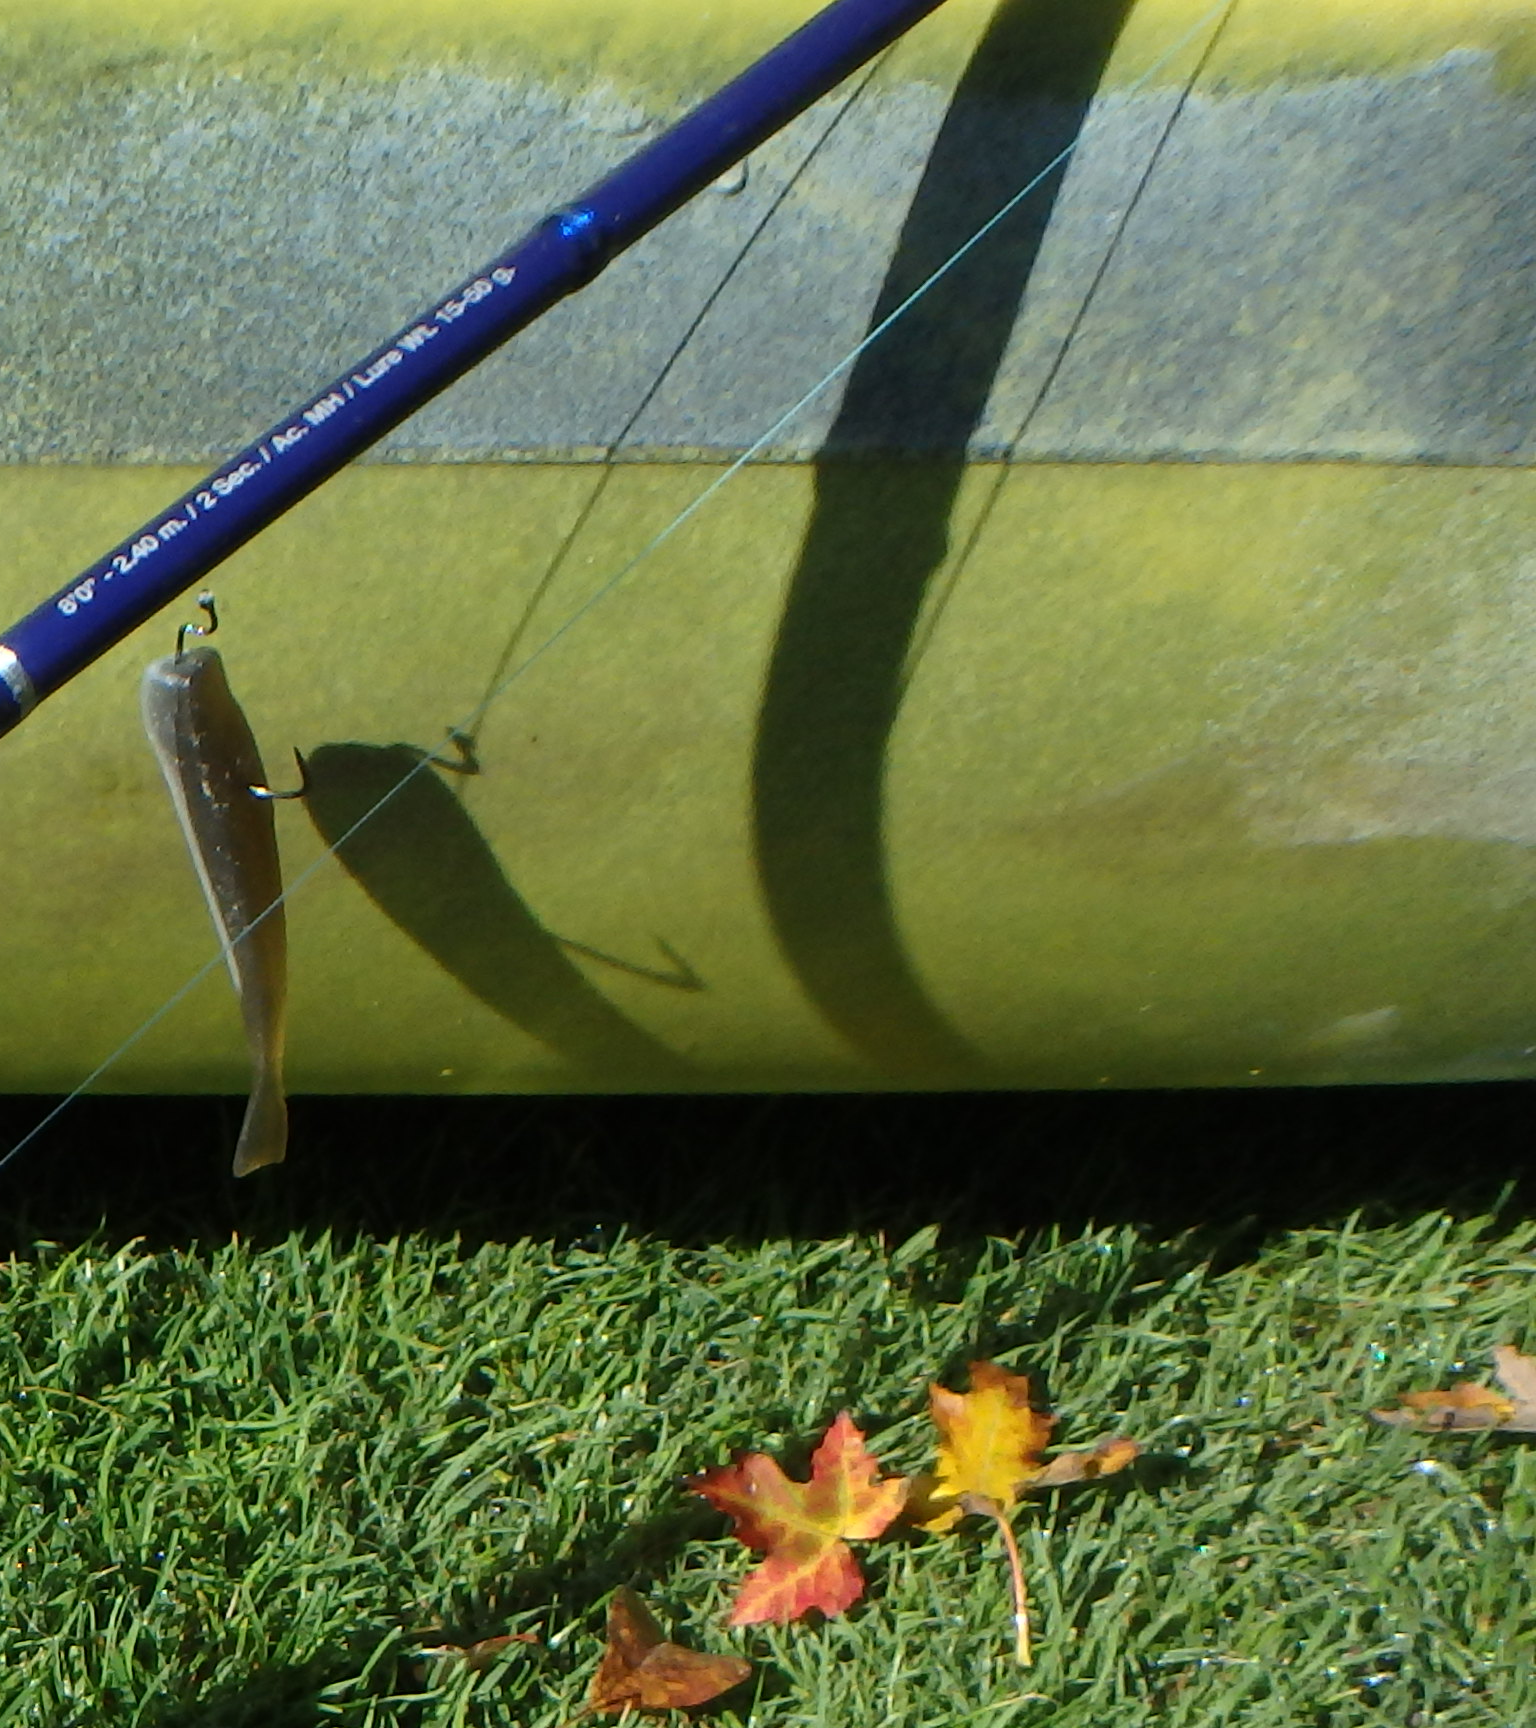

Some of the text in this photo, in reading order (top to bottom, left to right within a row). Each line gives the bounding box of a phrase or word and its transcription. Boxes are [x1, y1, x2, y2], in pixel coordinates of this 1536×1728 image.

[195, 489, 218, 512] 2
[212, 456, 261, 495] Sec.
[270, 426, 309, 455] Ac.
[353, 347, 404, 389] Lure
